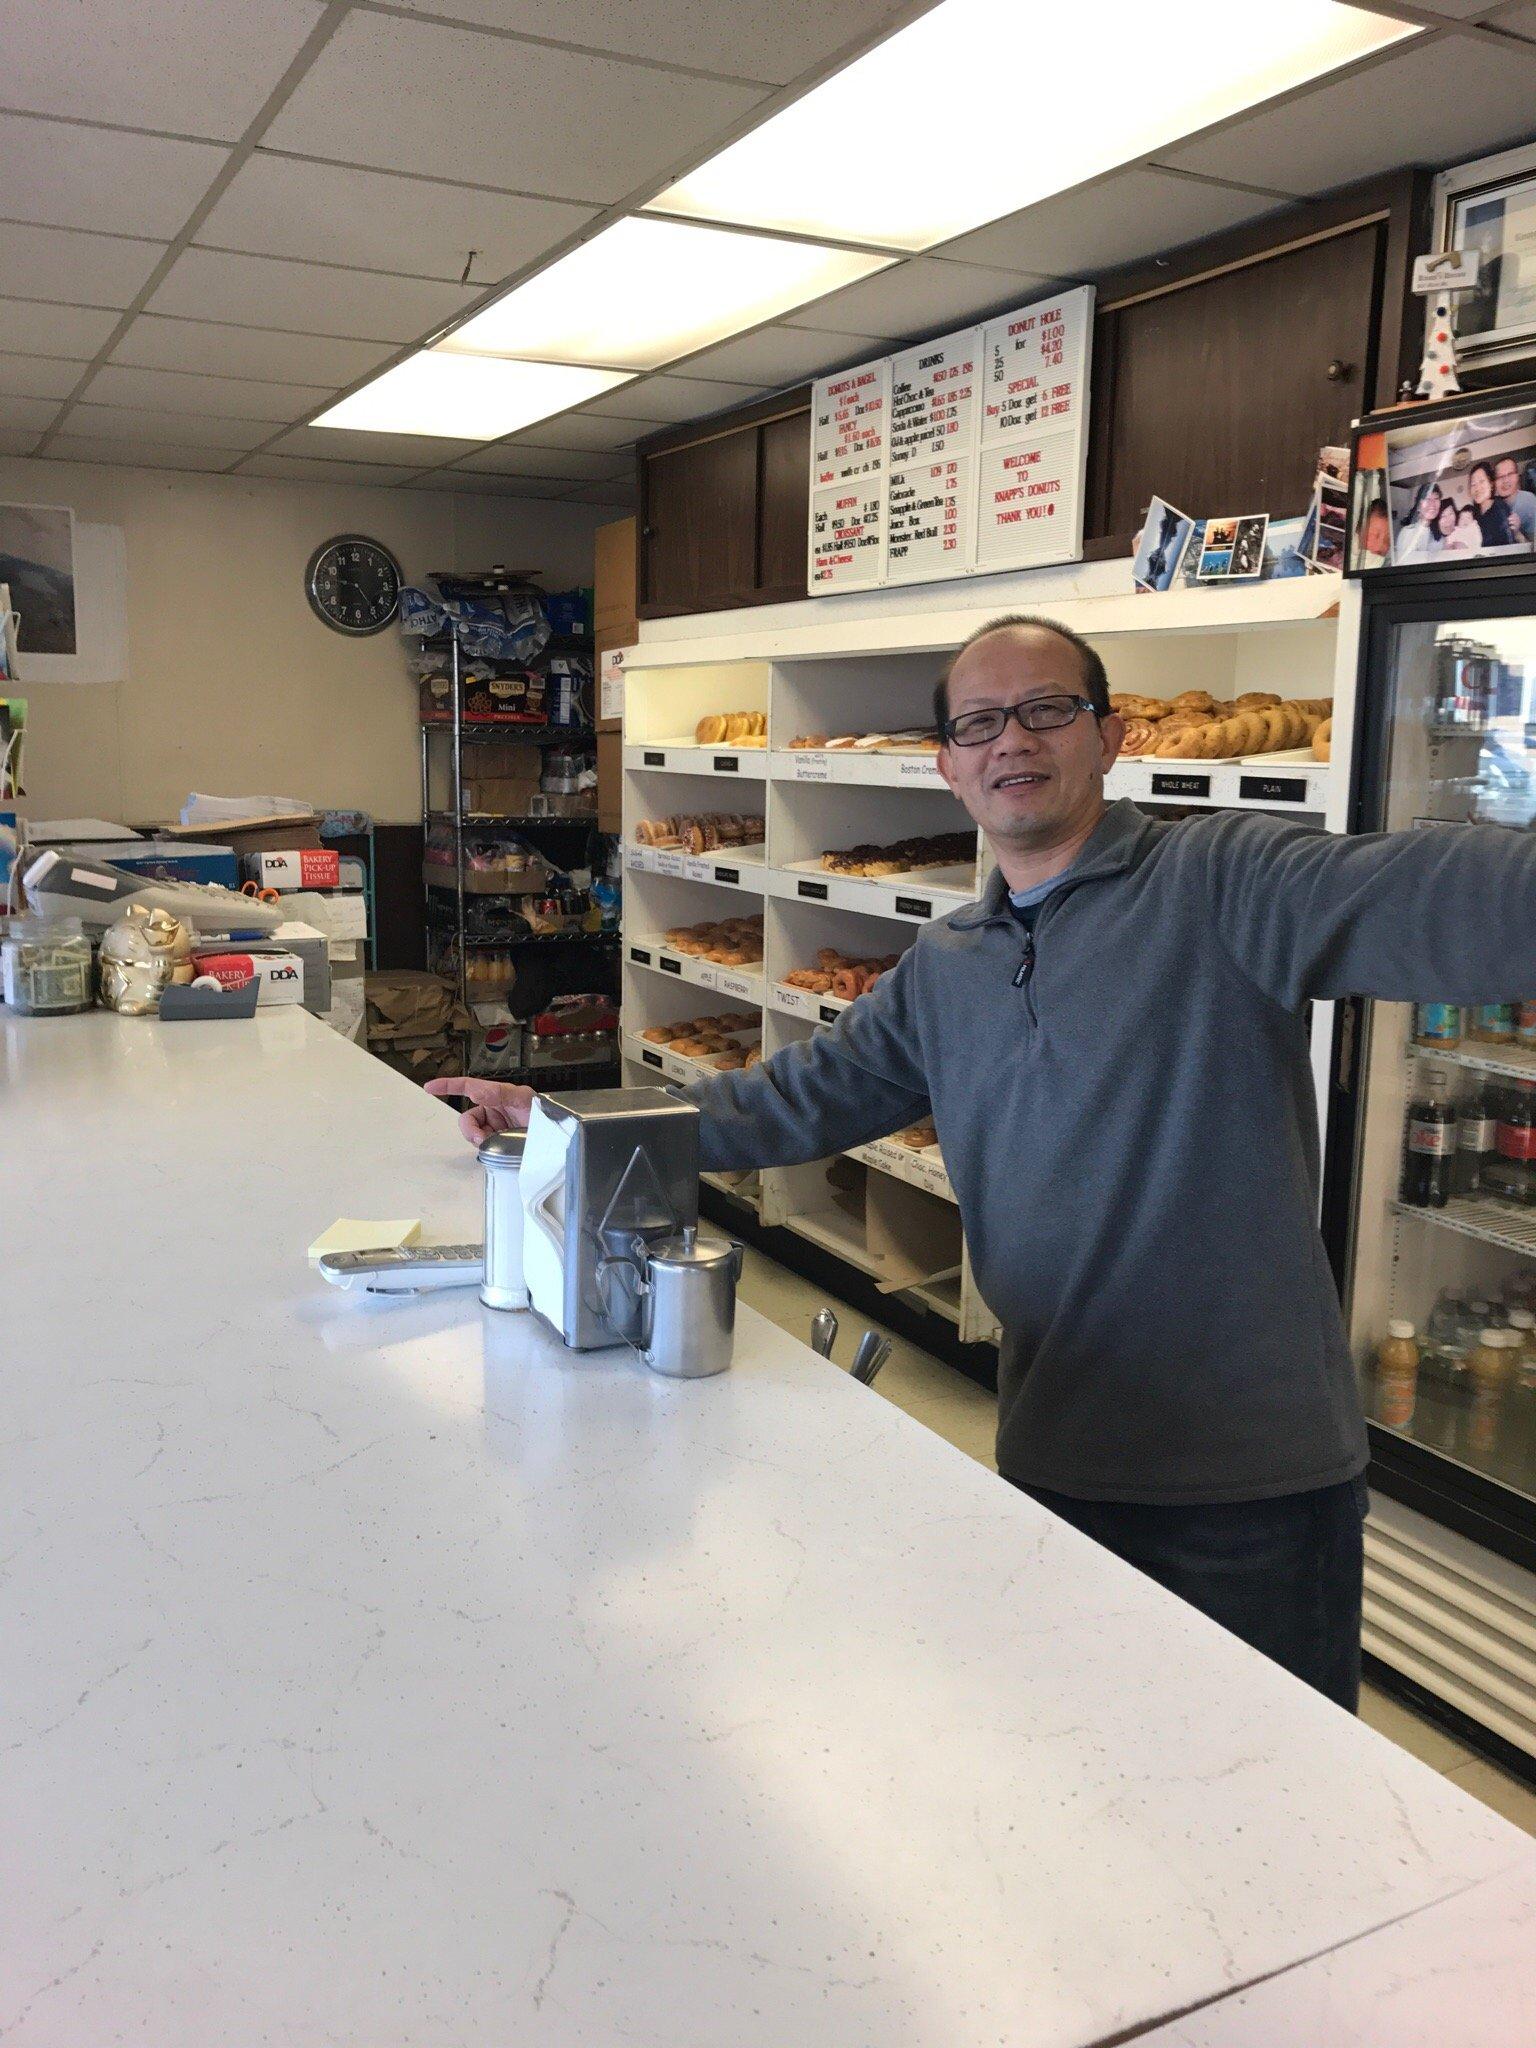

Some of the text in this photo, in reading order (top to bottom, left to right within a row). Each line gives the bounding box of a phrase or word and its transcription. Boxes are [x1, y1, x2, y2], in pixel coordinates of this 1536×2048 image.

[1008, 309, 1061, 336] DONUT HOLE
[919, 352, 944, 370] DRINKS
[1008, 376, 1038, 394] SPECIAL
[1025, 393, 1037, 408] get
[1052, 382, 1072, 398] FREE
[1025, 409, 1037, 425] get
[1051, 400, 1070, 415] FREE
[1004, 450, 1041, 469] WELCOME
[1016, 470, 1028, 482] TO
[994, 480, 1060, 502] KNAPP'S DONUTS
[996, 510, 1021, 524] THANK
[338, 557, 346, 566] 11
[351, 552, 360, 562] 12
[368, 558, 372, 566] 1
[328, 566, 337, 576] 10
[378, 568, 383, 577] 2
[325, 581, 330, 590] 9
[383, 582, 389, 591] 3
[331, 596, 336, 605] 8
[379, 597, 384, 605] 4
[342, 607, 346, 615] 7
[356, 610, 362, 618] 6
[371, 606, 376, 615] 5
[498, 704, 516, 712] Mini
[900, 764, 937, 775] Boston Crem
[1161, 781, 1200, 790] WHOLE WHEAT
[1262, 784, 1282, 792] PLAIN
[266, 860, 288, 868] DDA
[304, 864, 336, 872] PICK-UP
[209, 970, 246, 980] BAKERY
[270, 970, 298, 980] DDA
[777, 991, 800, 1006] TWIST
